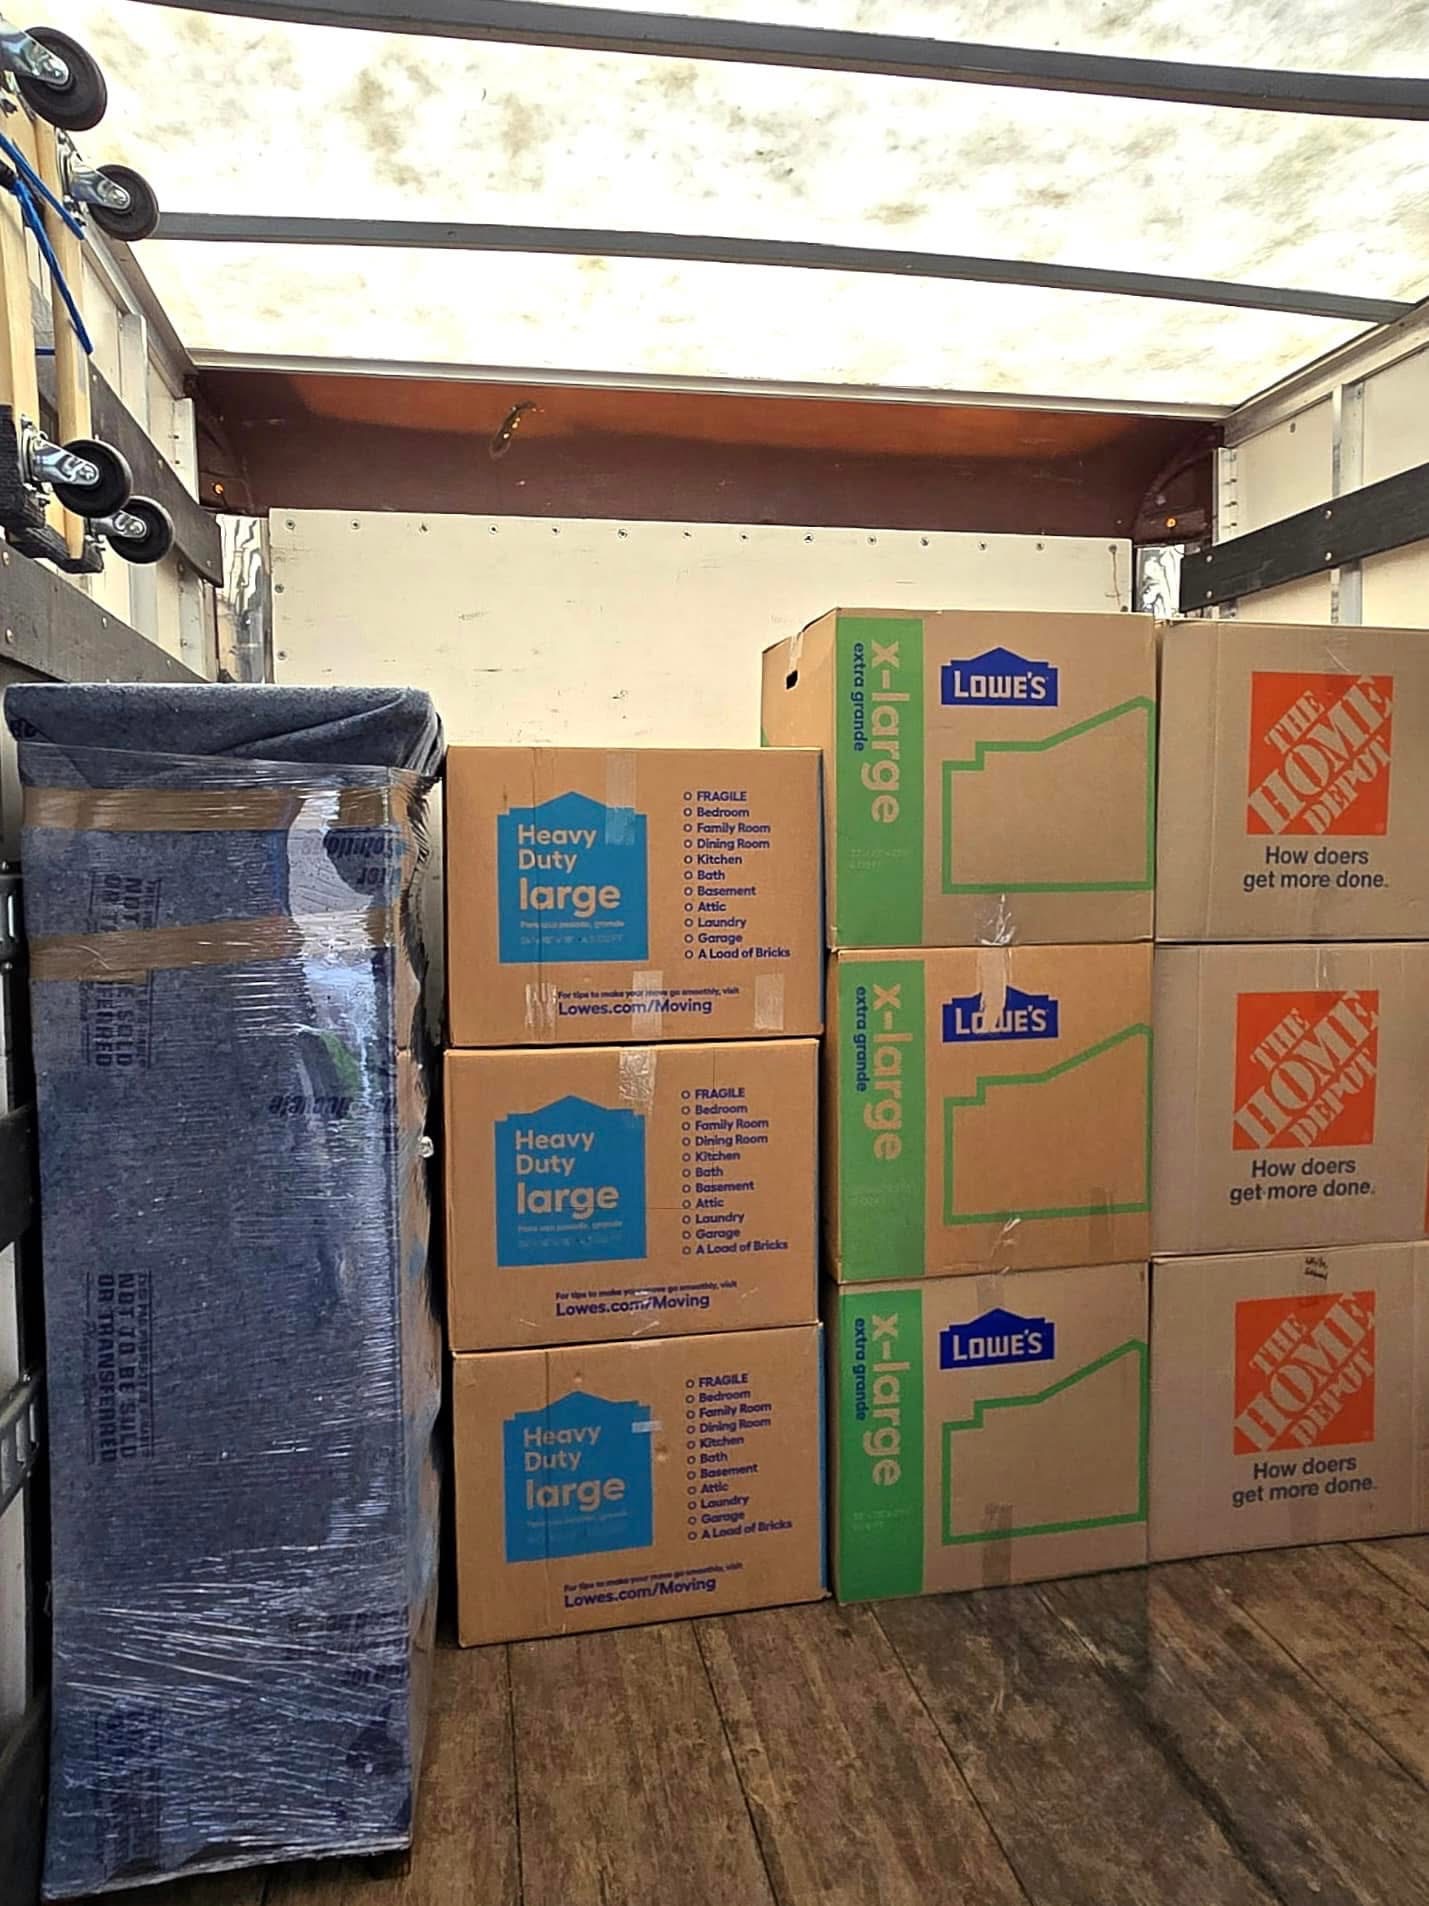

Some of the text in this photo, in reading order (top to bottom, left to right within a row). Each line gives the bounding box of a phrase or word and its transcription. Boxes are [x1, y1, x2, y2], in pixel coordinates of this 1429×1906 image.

[954, 670, 1046, 699] LOWE'S
[851, 642, 868, 751] extra grande
[861, 639, 910, 824] x-large
[1264, 690, 1325, 754] THE
[1249, 676, 1392, 834] HOME
[1303, 735, 1392, 834] DEPOT
[697, 791, 747, 801] FRAGILE
[697, 807, 749, 817] Bedroom
[517, 824, 597, 849] Heavy
[697, 822, 771, 835] Family Room
[697, 838, 770, 851] Dining Room
[518, 849, 577, 874] Duty
[697, 854, 742, 864] Kitchen
[1265, 846, 1369, 865] How doers
[697, 870, 725, 880] Bath
[1243, 872, 1275, 892] get
[1281, 874, 1330, 888] more
[519, 877, 622, 917] large
[697, 886, 756, 896] Basement
[698, 901, 726, 912] Attic
[698, 916, 746, 928] Laundry
[698, 932, 743, 945] Garage
[699, 947, 790, 959] A Load of Bricks
[559, 999, 712, 1015] Lowes.com/Moving
[853, 986, 869, 1092] extra grande
[1250, 1007, 1310, 1072] THE
[864, 984, 913, 1160] x-large
[1234, 990, 1379, 1149] HOME
[695, 1088, 745, 1099] FRAGILE
[1289, 1047, 1376, 1147] DEPOT
[696, 1104, 748, 1115] Bedroom
[696, 1119, 769, 1131] Family Room
[515, 1129, 595, 1152] Heavy
[696, 1135, 768, 1147] Dining Room
[515, 1154, 575, 1177] Duty
[696, 1151, 740, 1162] Kitchen
[696, 1167, 723, 1177] Bath
[1251, 1157, 1356, 1178] How doers
[696, 1181, 754, 1193] Basement
[1230, 1184, 1263, 1205] get
[1268, 1184, 1317, 1199] more
[516, 1182, 619, 1219] large
[696, 1197, 724, 1208] Attic
[695, 1212, 744, 1224] Laundry
[696, 1229, 740, 1239] Garage
[696, 1240, 788, 1254] A Load of Bricks
[953, 1331, 1042, 1360] LOWE'S
[1249, 1313, 1307, 1375] THE
[98, 1274, 117, 1462] OR TRANSFERRED
[118, 1273, 136, 1458] NOT TO BE SOLD
[852, 1318, 869, 1421] extra grande
[1234, 1292, 1375, 1450] HOME
[699, 1373, 748, 1387] FRAGILE
[699, 1391, 750, 1402] Bedroom
[864, 1314, 910, 1486] x-large
[1291, 1347, 1374, 1447] DEPOT
[699, 1403, 771, 1418] Family Room
[700, 1419, 771, 1433] Dining Room
[523, 1425, 602, 1451] Heavy
[700, 1436, 744, 1448] Kitchen
[524, 1450, 582, 1472] Duty
[700, 1452, 728, 1464] Bath
[700, 1464, 757, 1478] Basement
[1253, 1456, 1357, 1480] How doers
[525, 1476, 626, 1511] large
[701, 1482, 728, 1493] Attic
[1232, 1488, 1264, 1507] get
[1270, 1483, 1319, 1500] more
[701, 1496, 749, 1508] Laundry
[701, 1513, 744, 1523] Garage
[702, 1520, 792, 1539] A Load of Bricks
[564, 1578, 716, 1608] Lowes.com/Moving
